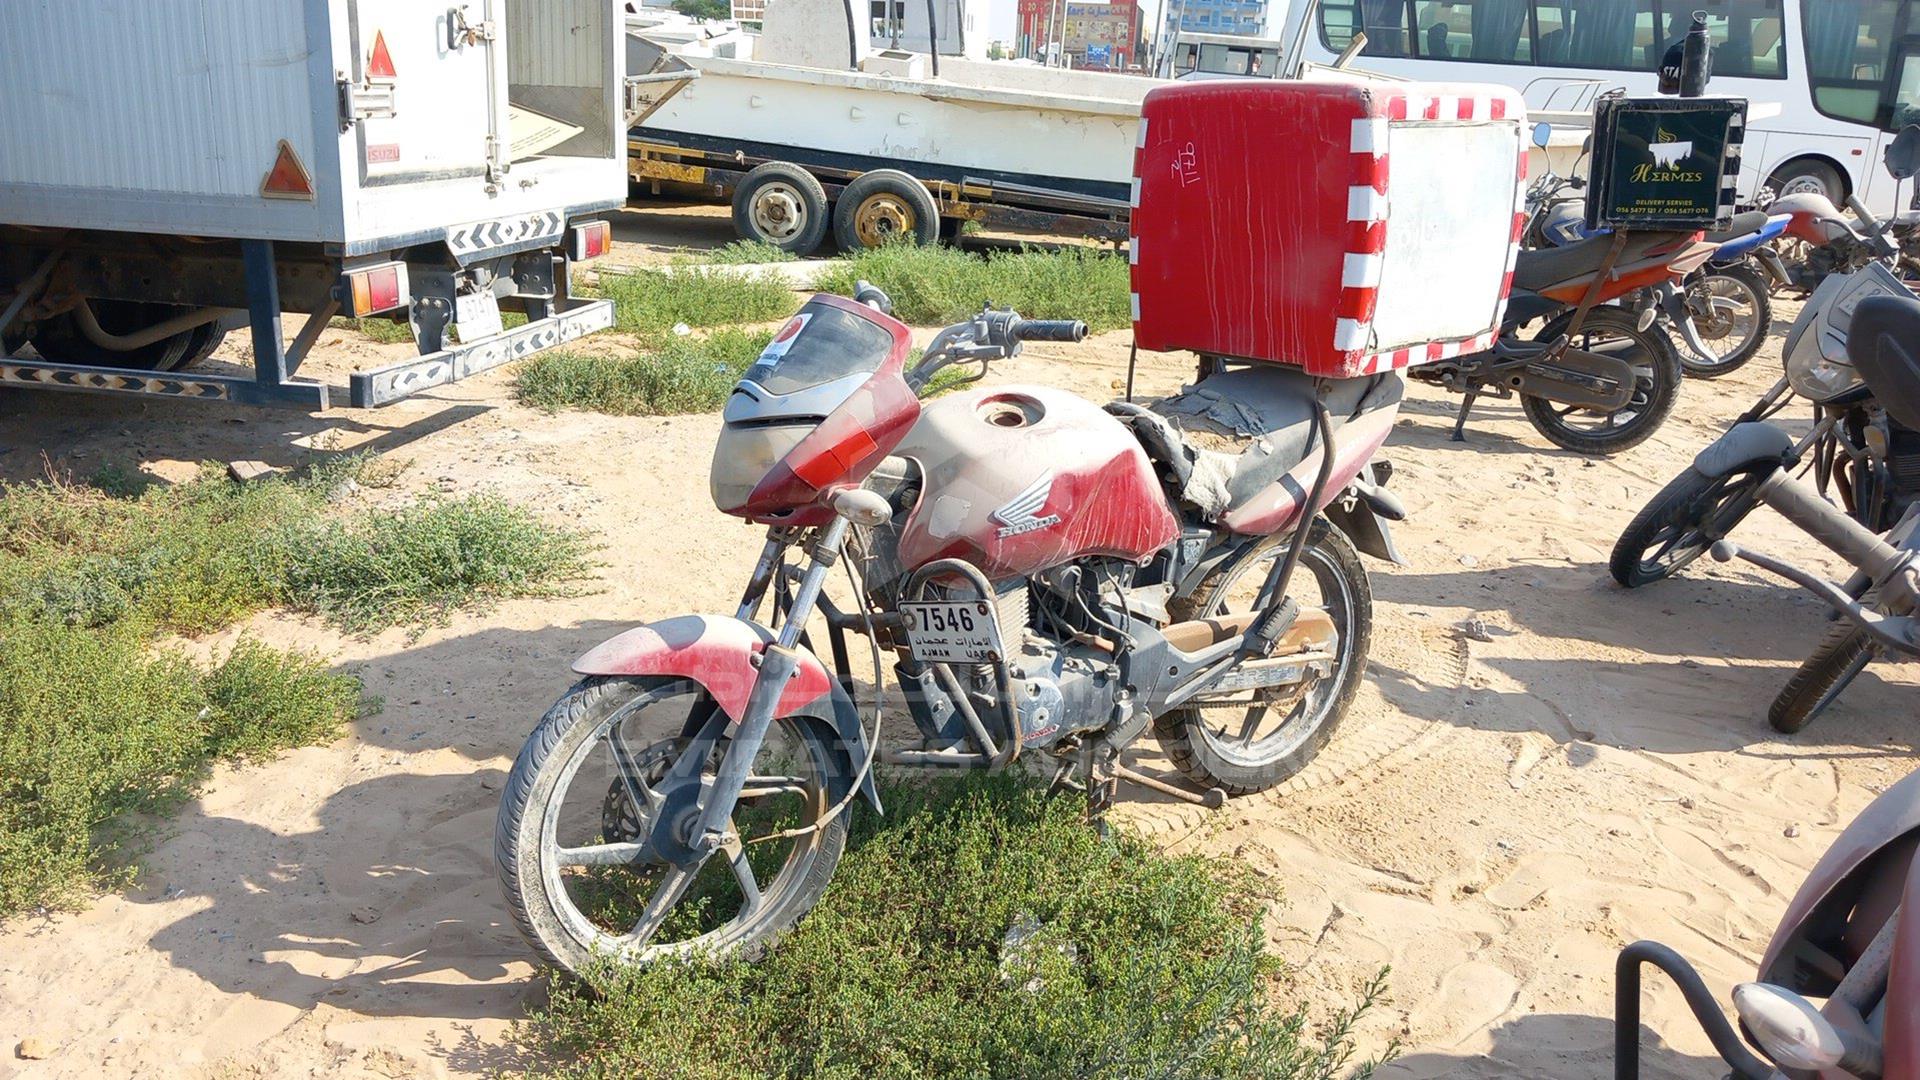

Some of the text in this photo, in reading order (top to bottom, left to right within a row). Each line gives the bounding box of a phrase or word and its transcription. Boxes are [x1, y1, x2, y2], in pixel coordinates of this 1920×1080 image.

[1663, 65, 1680, 79] STA
[367, 145, 400, 161] ISUZU
[1629, 163, 1703, 183] HERMES
[916, 607, 974, 632] 7546
[921, 648, 987, 660] AJMAN UAE
